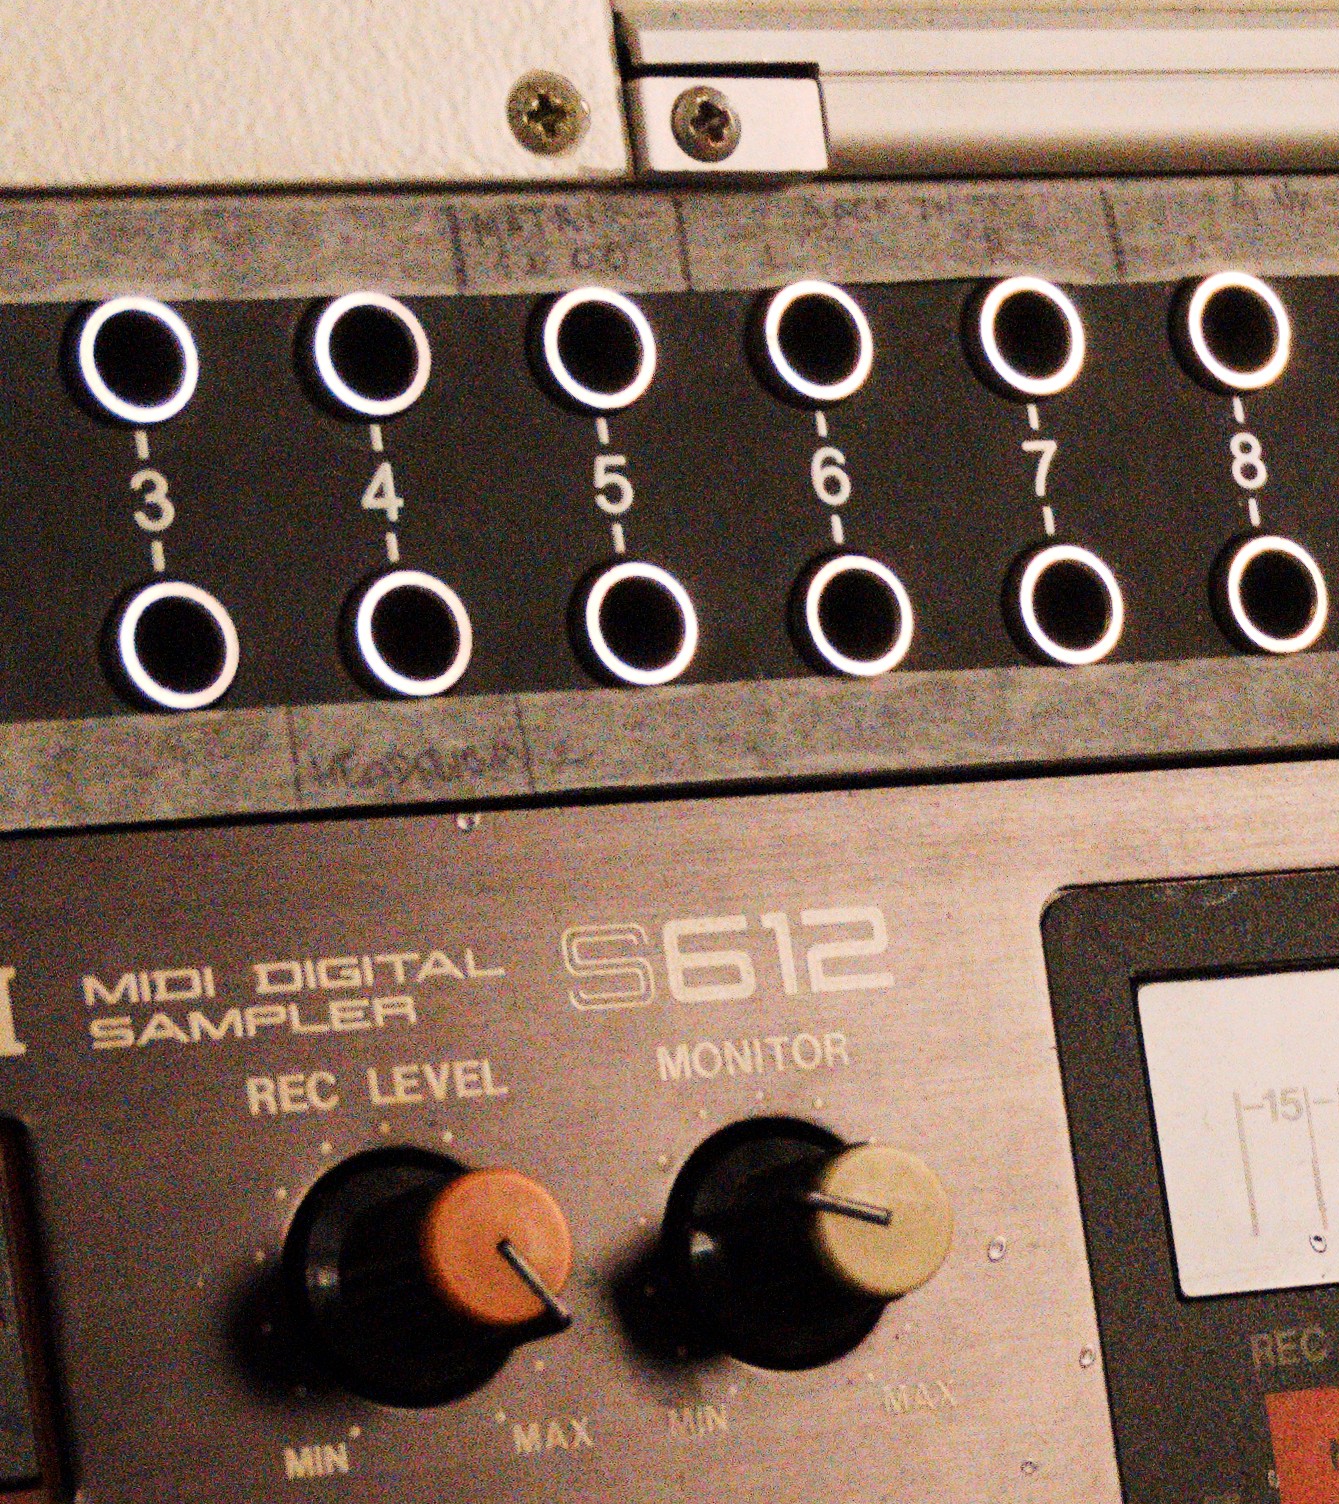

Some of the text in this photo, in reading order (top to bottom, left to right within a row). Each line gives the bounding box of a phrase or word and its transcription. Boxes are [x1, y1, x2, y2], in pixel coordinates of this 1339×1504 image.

[593, 454, 634, 515] 5
[810, 447, 851, 506] 6
[1021, 439, 1058, 497] 7
[1229, 431, 1268, 490] 8
[130, 468, 176, 532] 3
[361, 461, 404, 522] 4
[82, 948, 511, 1005] MIDI DIGITAL
[561, 903, 894, 1010] S612
[90, 993, 418, 1049] SAMPLER
[656, 1029, 850, 1081] MONITOR
[247, 1058, 509, 1115] REC LEVEL
[1249, 1325, 1328, 1371] REC
[284, 1443, 350, 1479] MIN
[512, 1417, 593, 1453] MAX
